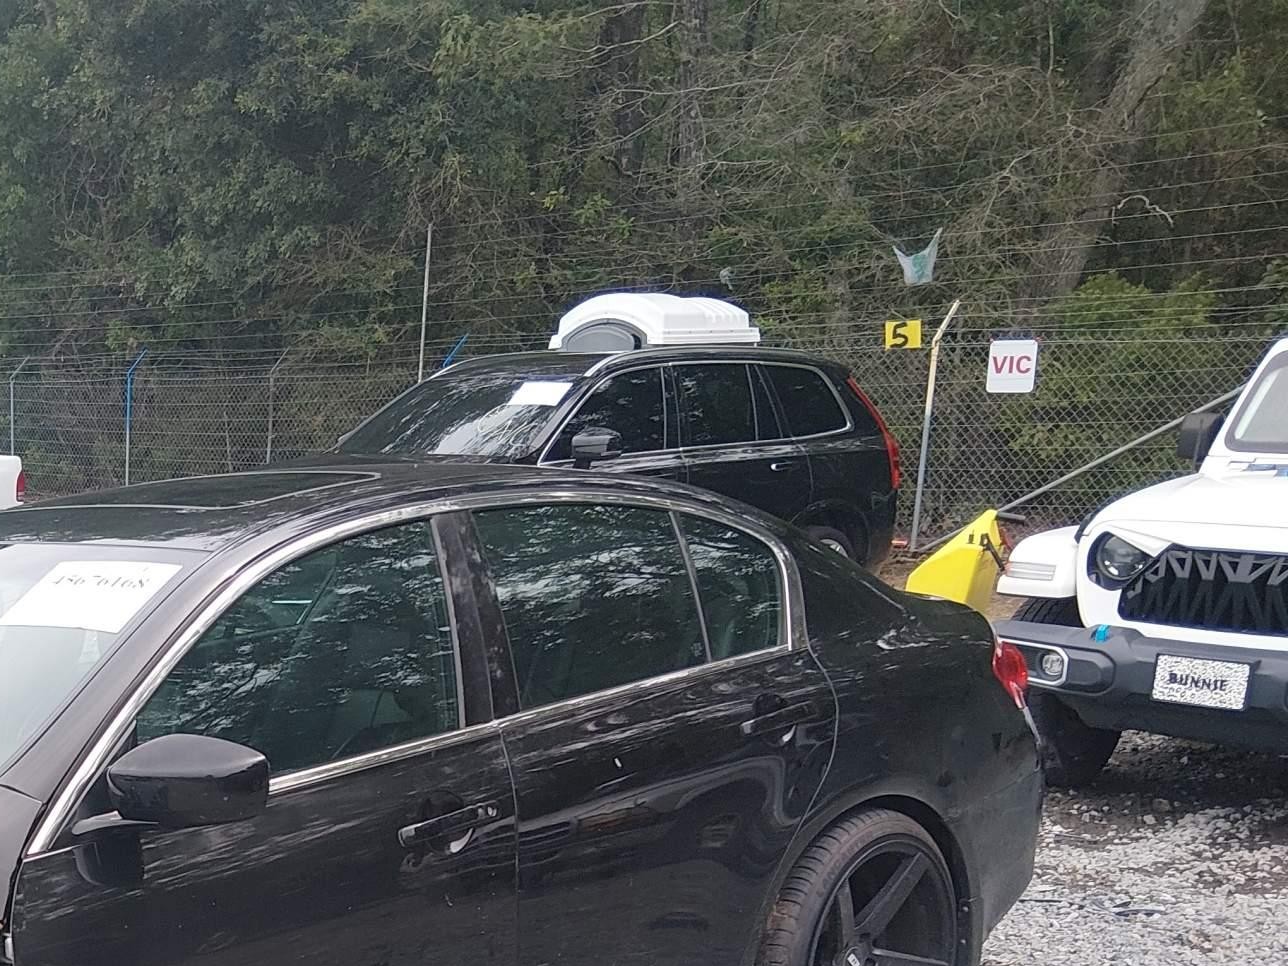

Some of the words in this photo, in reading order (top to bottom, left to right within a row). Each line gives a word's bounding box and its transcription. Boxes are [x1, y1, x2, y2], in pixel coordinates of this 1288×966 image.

[889, 322, 908, 348] 5
[992, 355, 1032, 374] VIC
[1168, 673, 1227, 692] BUNNIE
